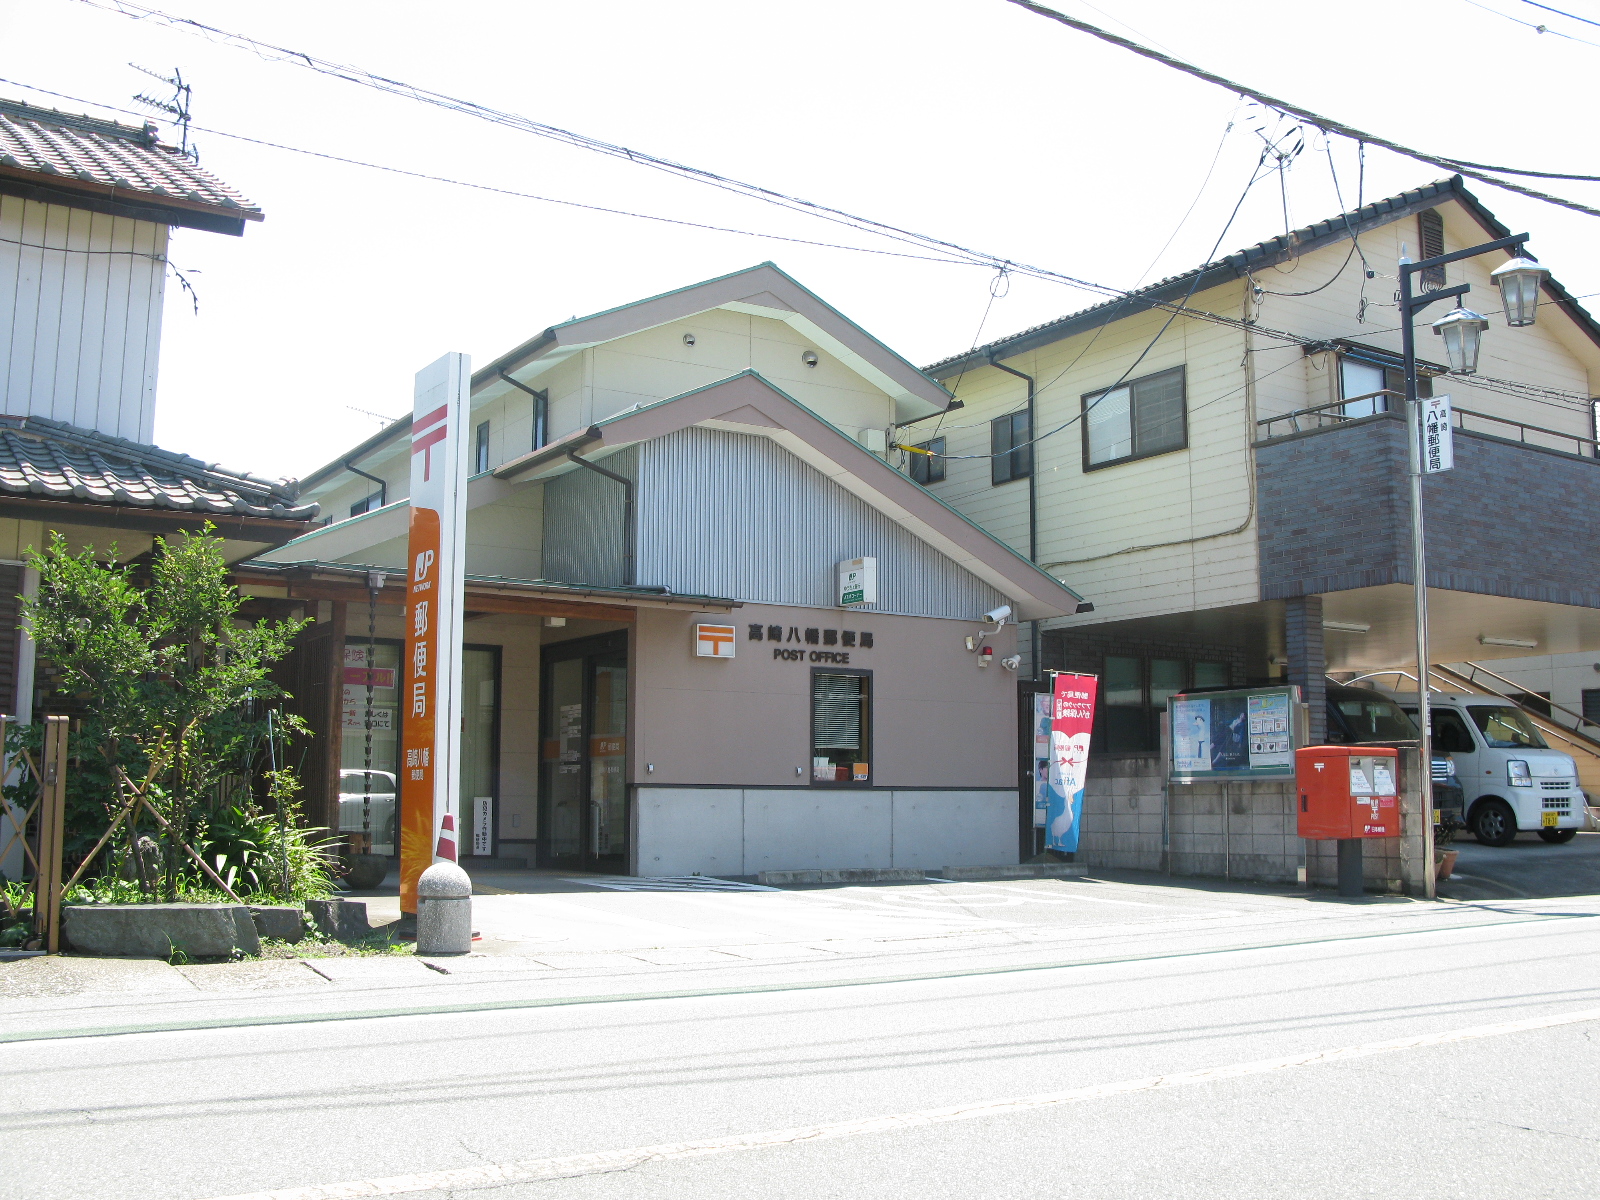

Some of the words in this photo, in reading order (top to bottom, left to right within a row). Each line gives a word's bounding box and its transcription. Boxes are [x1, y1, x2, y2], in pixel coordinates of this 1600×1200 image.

[1427, 410, 1440, 470] 八幡郵便局
[748, 624, 874, 648] 高崎八幡郵便局
[412, 600, 429, 719] 郵便局
[773, 648, 806, 661] POST
[809, 650, 850, 664] OFFICE
[365, 720, 390, 728] 口にて
[406, 747, 430, 768] 高崎八幡
